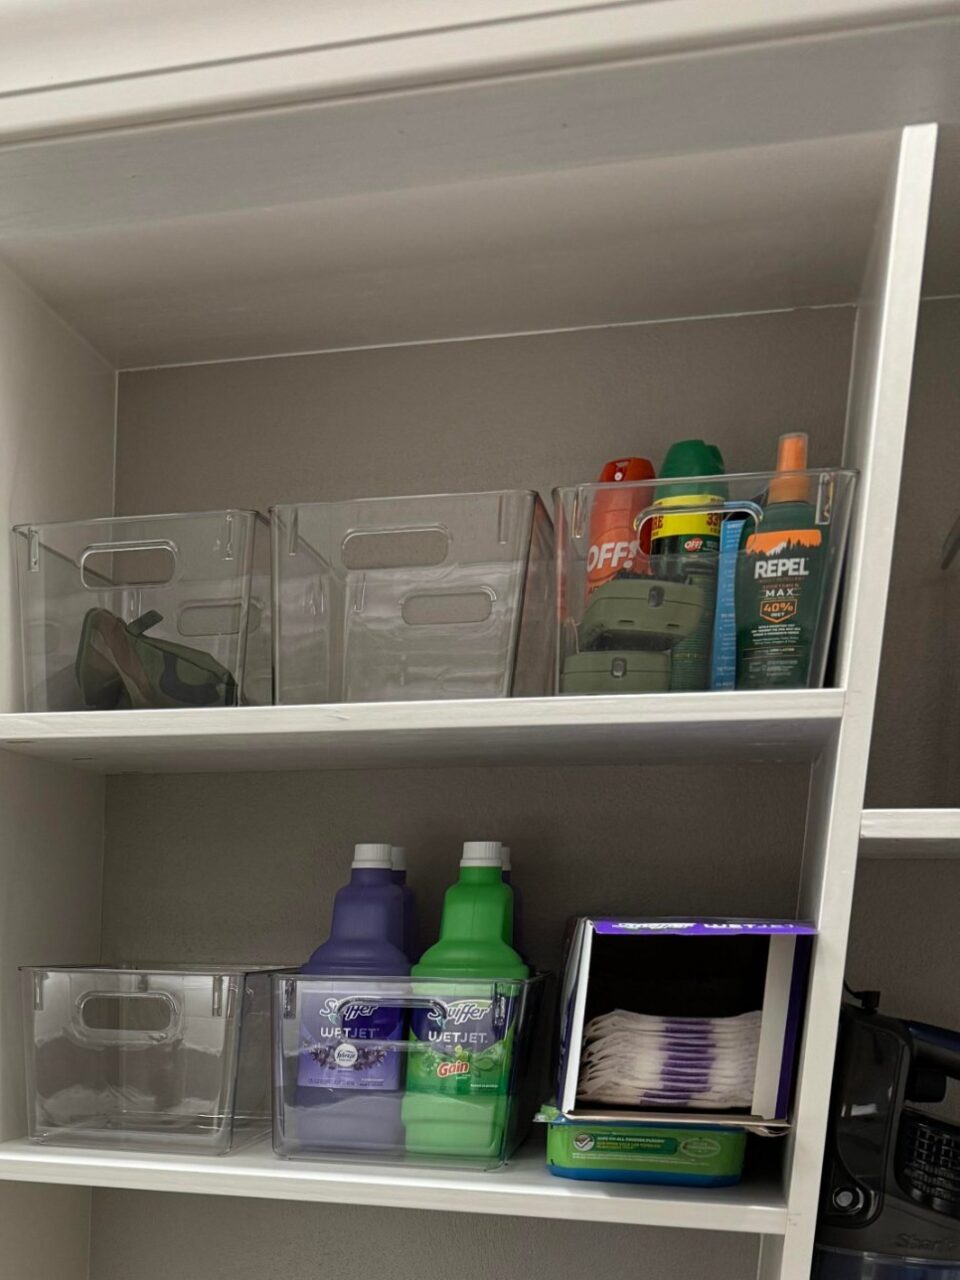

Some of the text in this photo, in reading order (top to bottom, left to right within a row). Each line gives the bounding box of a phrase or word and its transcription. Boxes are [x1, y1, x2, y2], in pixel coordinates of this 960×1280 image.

[684, 538, 703, 551] OFF!
[586, 540, 639, 572] OFF!
[754, 557, 810, 579] REPEL
[765, 588, 795, 598] MAX
[763, 602, 793, 613] 40%
[319, 998, 379, 1021] Sffer
[427, 1001, 490, 1024] Siffer
[320, 1027, 376, 1038] WETJET
[428, 1031, 486, 1043] WETJET
[437, 1060, 470, 1078] Gain
